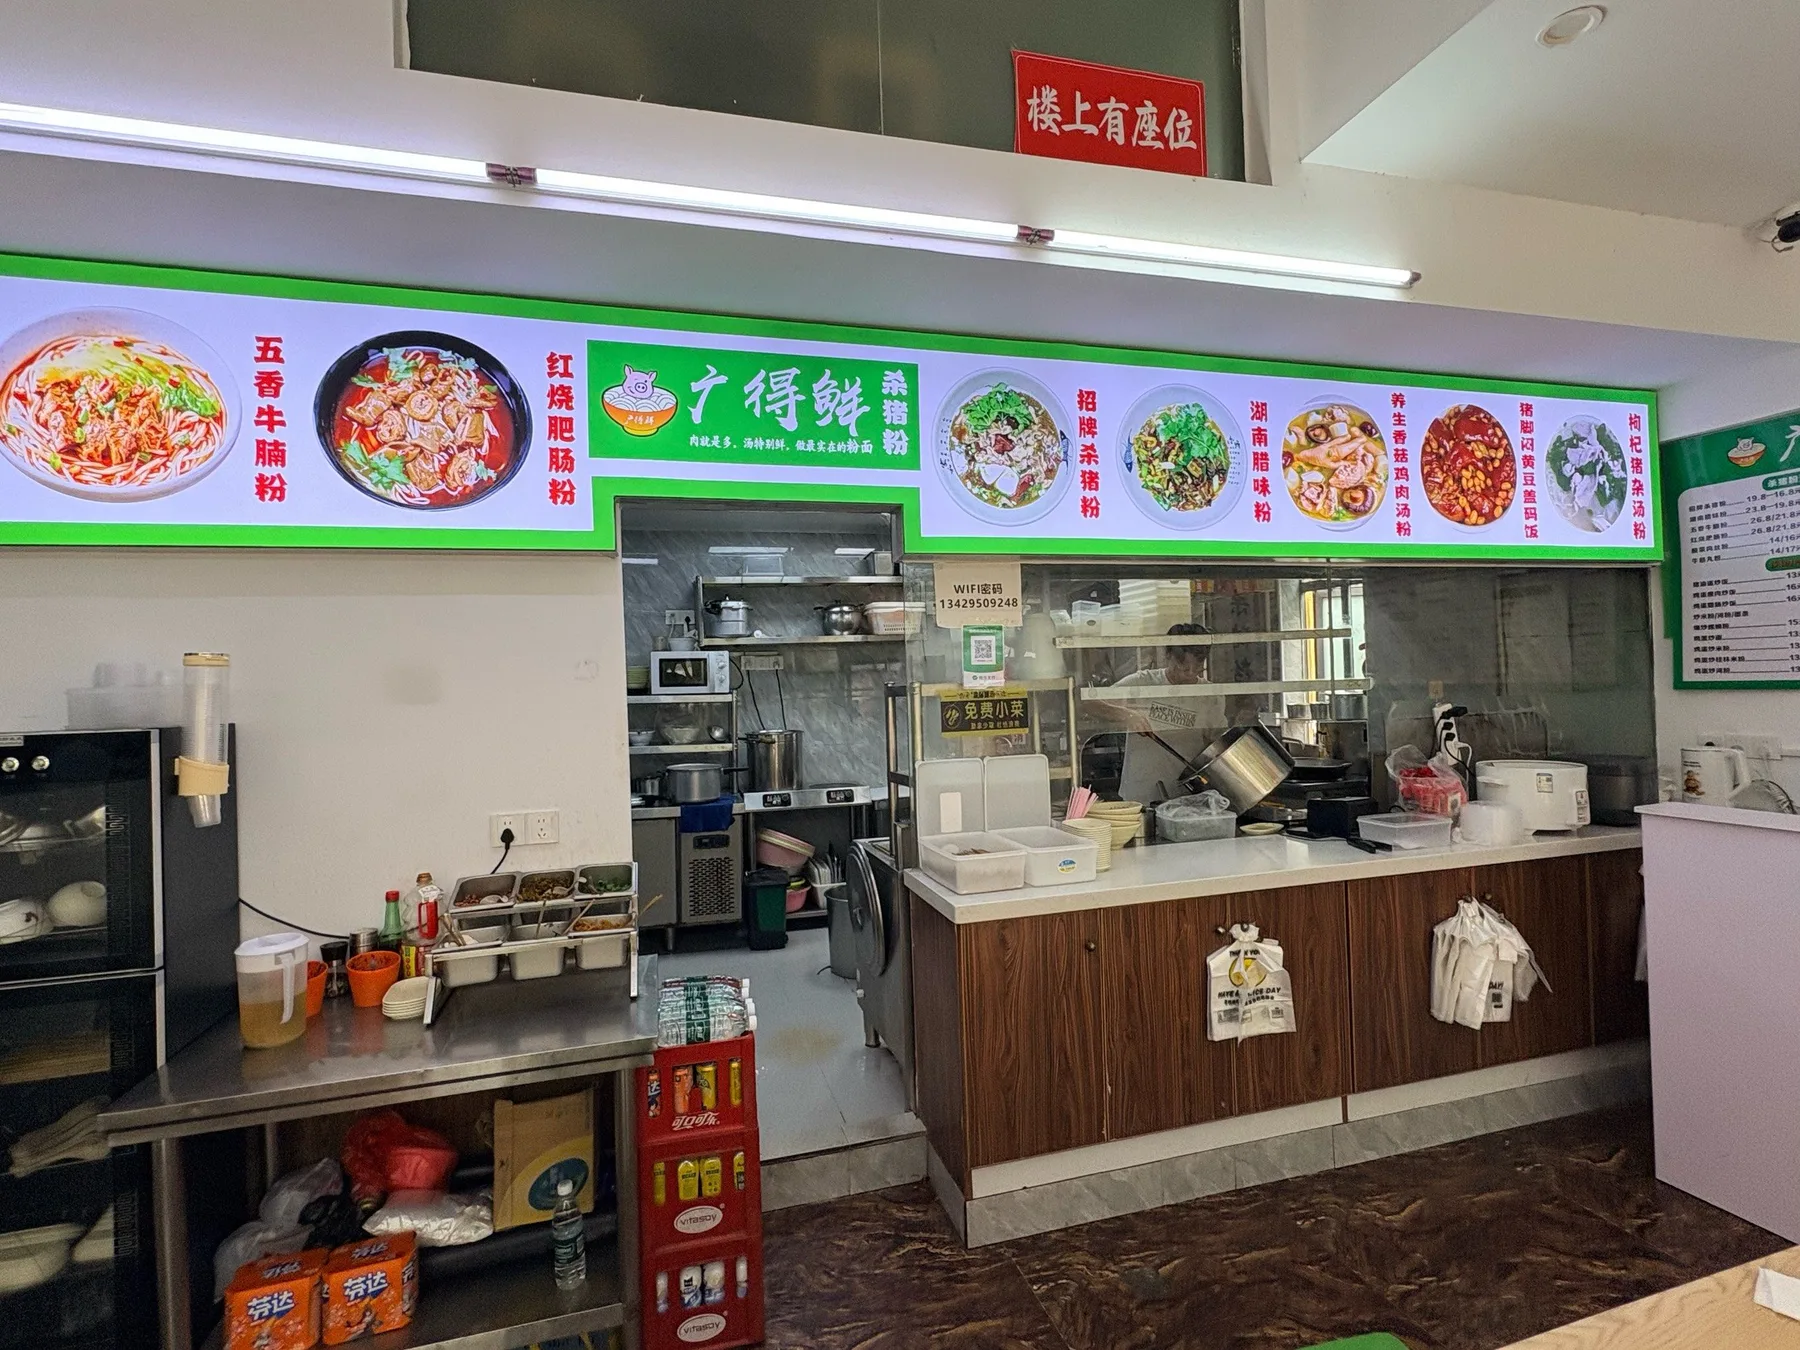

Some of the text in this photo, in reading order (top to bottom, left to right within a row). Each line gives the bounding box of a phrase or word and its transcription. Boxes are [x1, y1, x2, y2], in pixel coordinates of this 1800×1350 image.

[1027, 85, 1197, 151] 楼上有座位
[254, 335, 287, 503] 五香牛腩粉
[688, 365, 870, 437] 广得鲜
[881, 369, 909, 456] 杀猪粉
[547, 352, 577, 507] 红烧肥肠粉
[1077, 389, 1100, 519] 招牌杀猪粉
[1250, 401, 1271, 523] 湖南腊味粉
[1390, 392, 1411, 537] 养生香菇鸡肉汤粉
[1628, 413, 1647, 540] 枸杞猪杂汤粉
[940, 598, 1018, 609] 13429509248
[954, 583, 1003, 595] WIFI密码
[965, 700, 1024, 720] 免费小菜
[1266, 986, 1281, 994] DAY
[672, 1112, 718, 1130] 可口可乐
[680, 1213, 717, 1226] vitasoy
[247, 1290, 296, 1321] 芬达
[344, 1270, 388, 1301] 芬达
[683, 1321, 721, 1334] vitasoy
